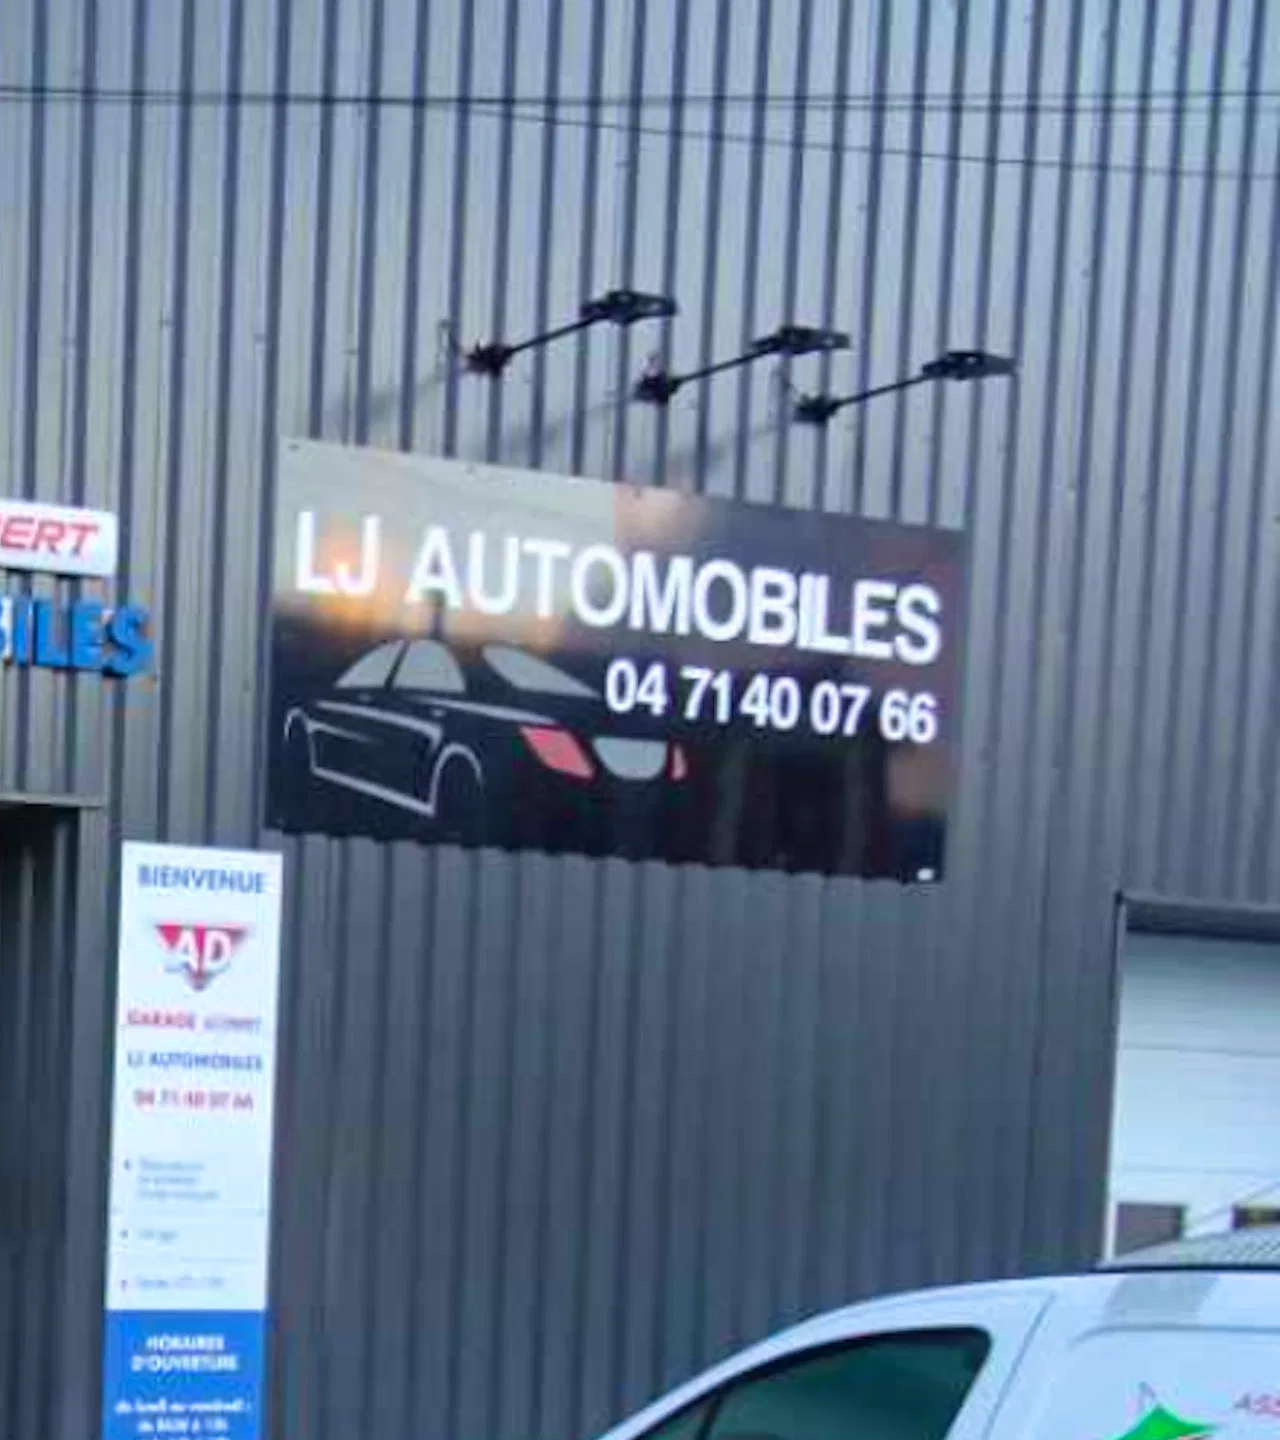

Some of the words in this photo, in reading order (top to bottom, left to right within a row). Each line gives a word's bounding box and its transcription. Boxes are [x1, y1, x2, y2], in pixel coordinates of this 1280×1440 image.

[295, 510, 381, 596] LJ
[405, 526, 942, 665] AUTOMOBILES
[605, 658, 667, 717] 04
[679, 665, 733, 723] 71
[739, 672, 800, 731] 40
[810, 680, 872, 736] 07
[880, 690, 937, 745] 66
[139, 864, 268, 894] BIENVENUE
